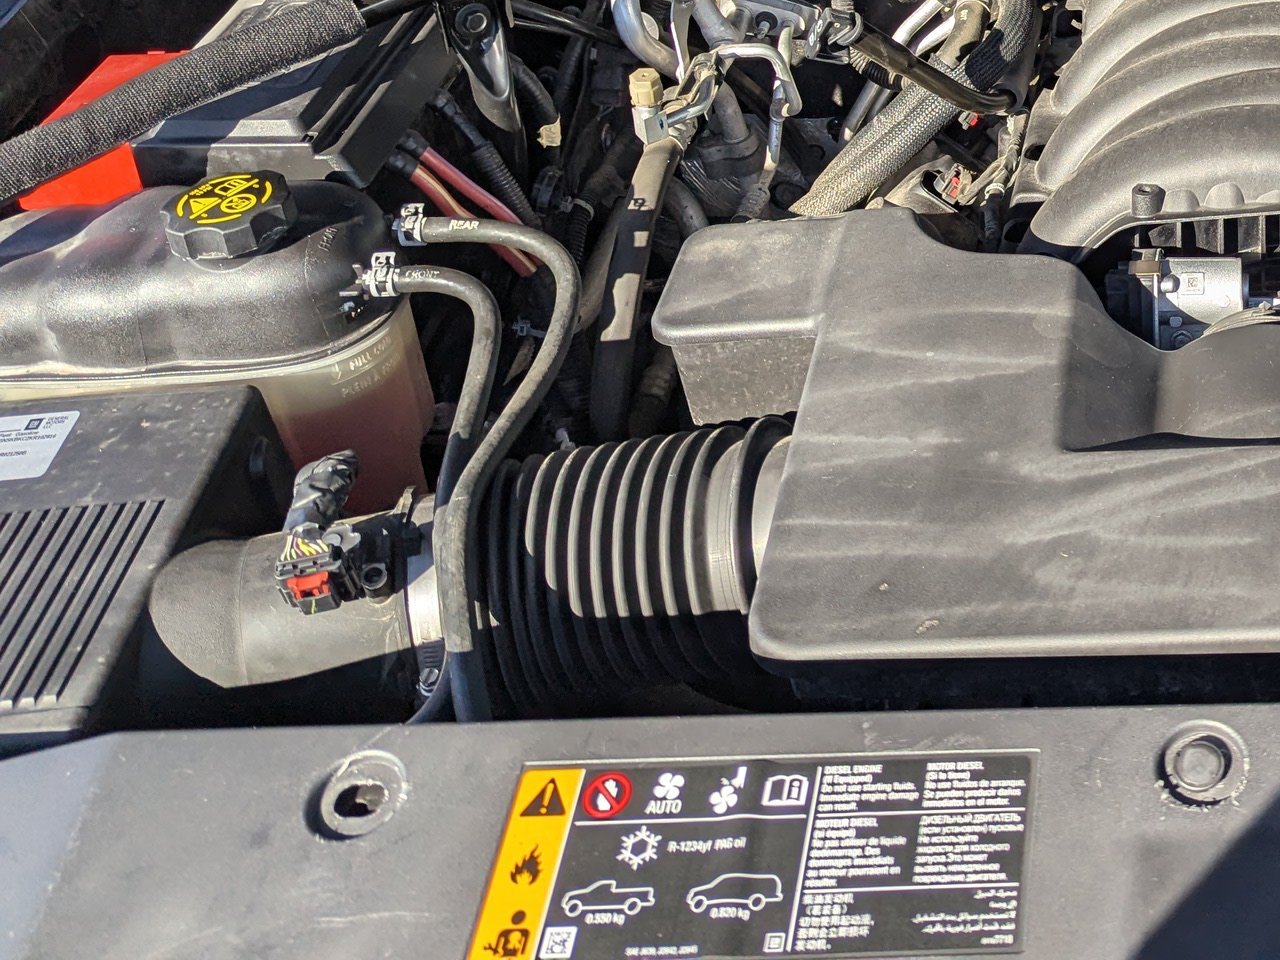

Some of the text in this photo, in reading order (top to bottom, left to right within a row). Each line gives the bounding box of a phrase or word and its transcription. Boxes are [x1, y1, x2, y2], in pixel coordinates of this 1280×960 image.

[449, 220, 479, 230] REAR
[405, 270, 440, 279] FRONT
[824, 764, 883, 774] DIESEL ENGINE
[956, 762, 984, 770] DIESEL
[644, 800, 682, 814] AUTO
[850, 818, 878, 828] DIESEL
[612, 912, 626, 926] kg
[737, 908, 750, 921] kg
